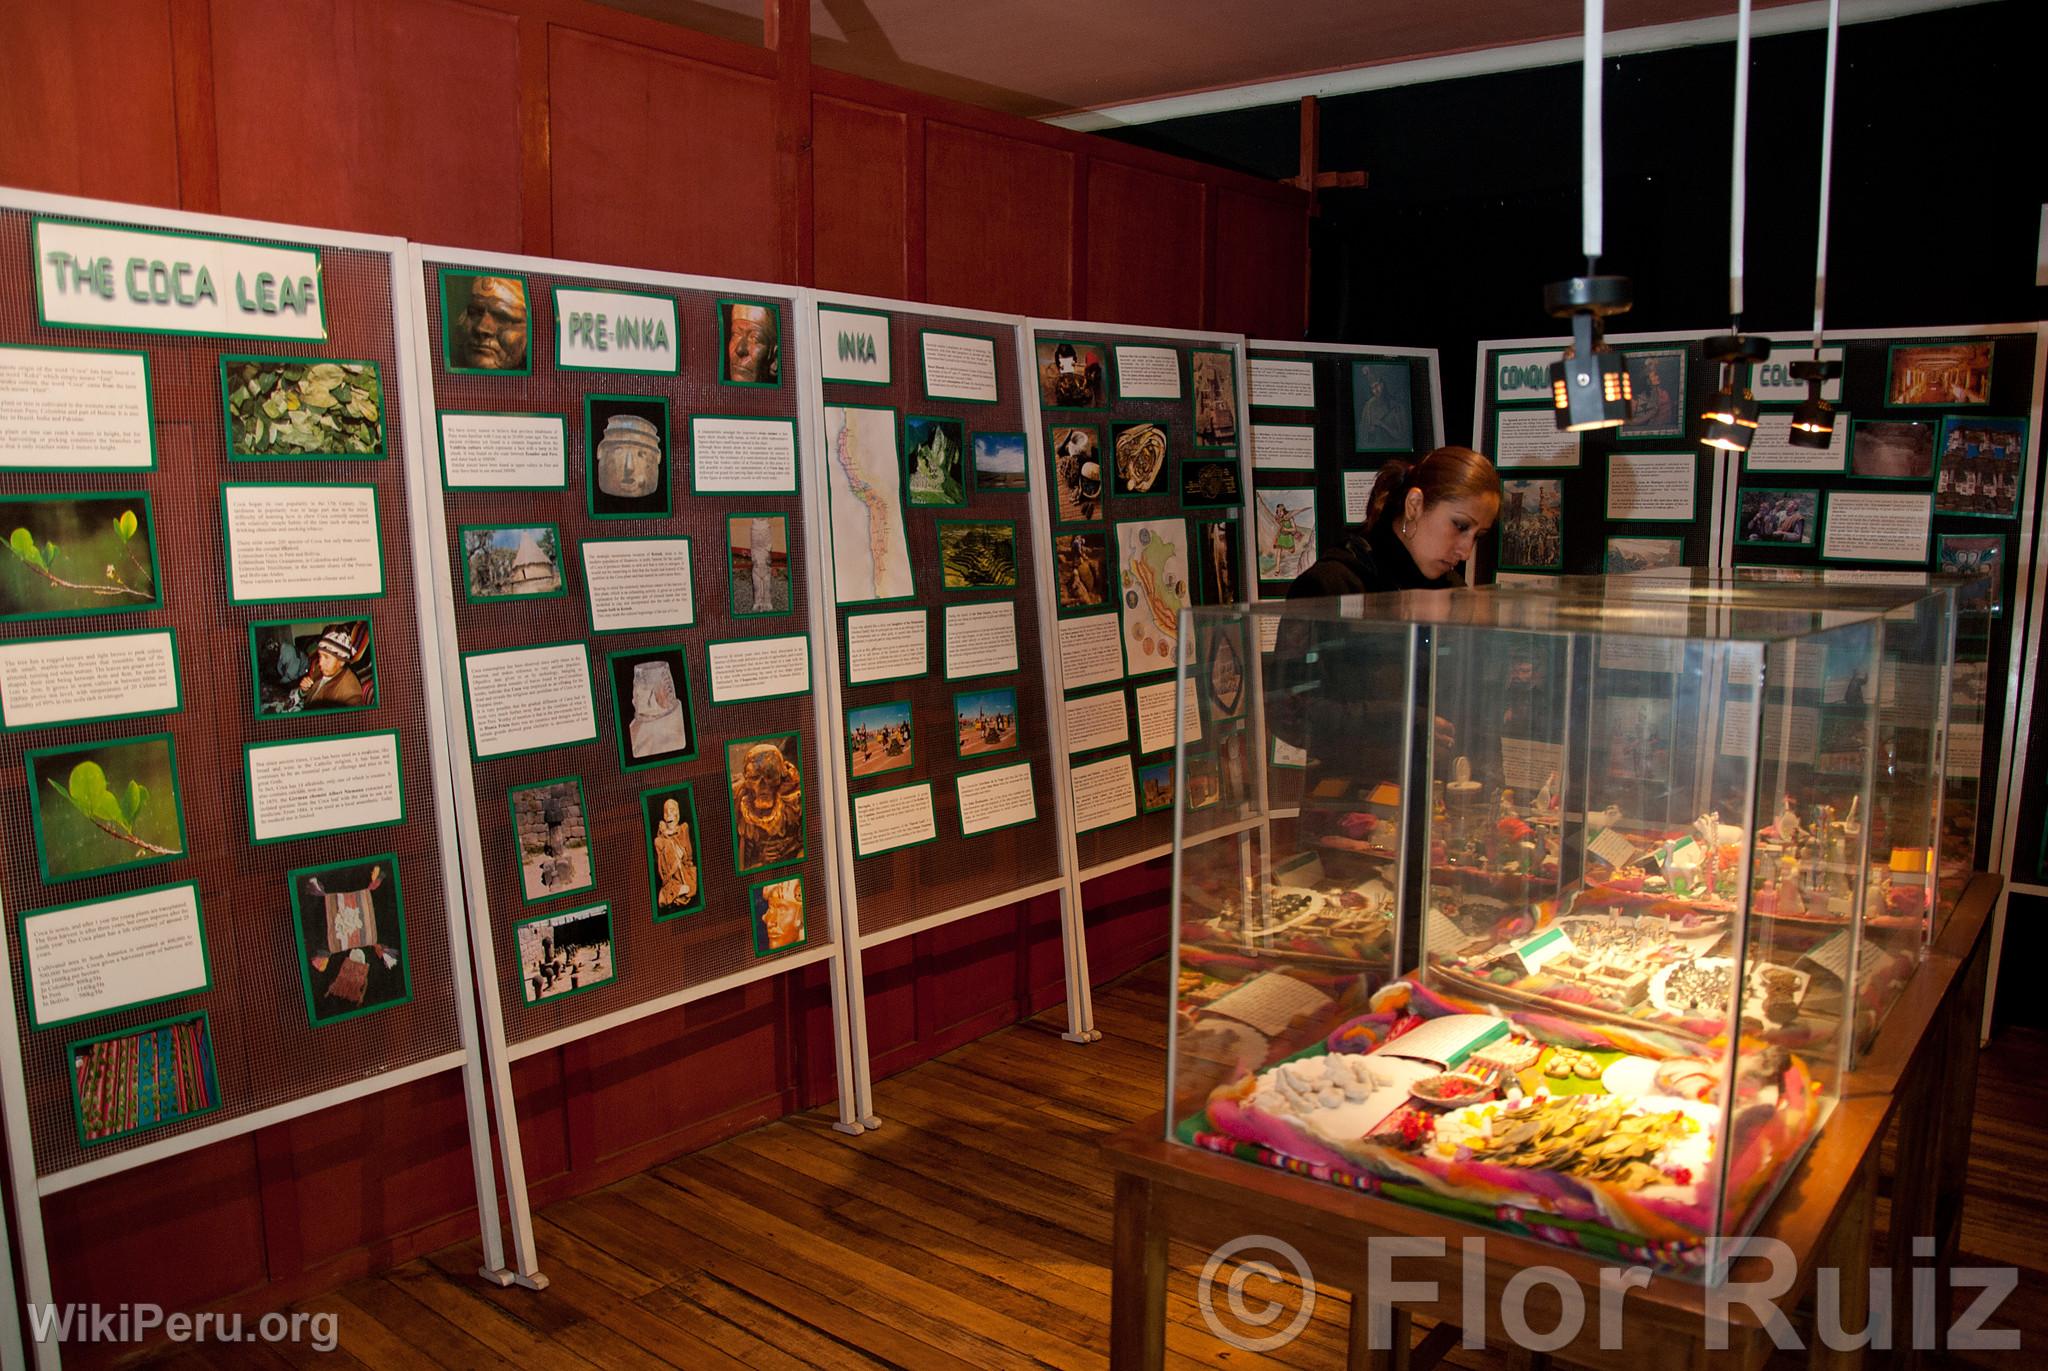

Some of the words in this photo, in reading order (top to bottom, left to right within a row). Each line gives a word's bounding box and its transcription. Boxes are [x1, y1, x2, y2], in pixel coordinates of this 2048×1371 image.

[47, 251, 115, 298] THE
[125, 256, 217, 306] COCA
[235, 269, 317, 317] LEAF
[568, 311, 670, 352] PRE-INKA
[837, 330, 877, 363] INKA
[1500, 364, 1551, 391] CONQU
